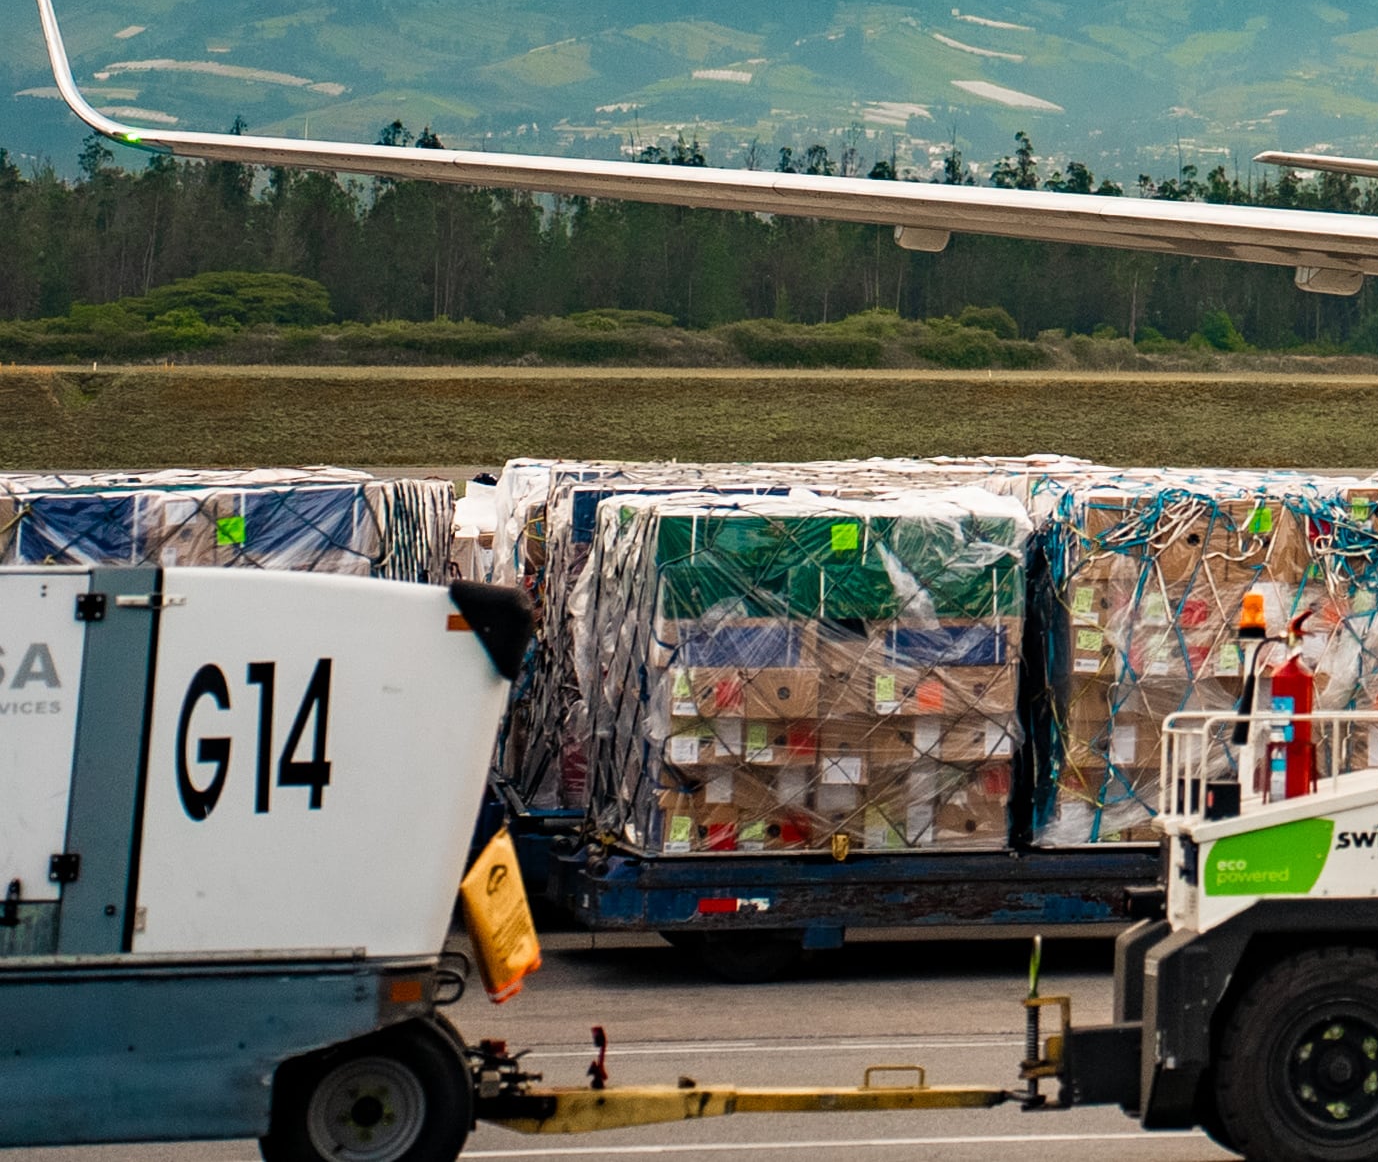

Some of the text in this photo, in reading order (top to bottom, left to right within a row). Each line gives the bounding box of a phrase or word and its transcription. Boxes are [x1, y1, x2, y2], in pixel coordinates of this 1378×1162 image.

[175, 657, 333, 822] G14
[1216, 859, 1247, 872] eco
[1216, 867, 1290, 887] powered
